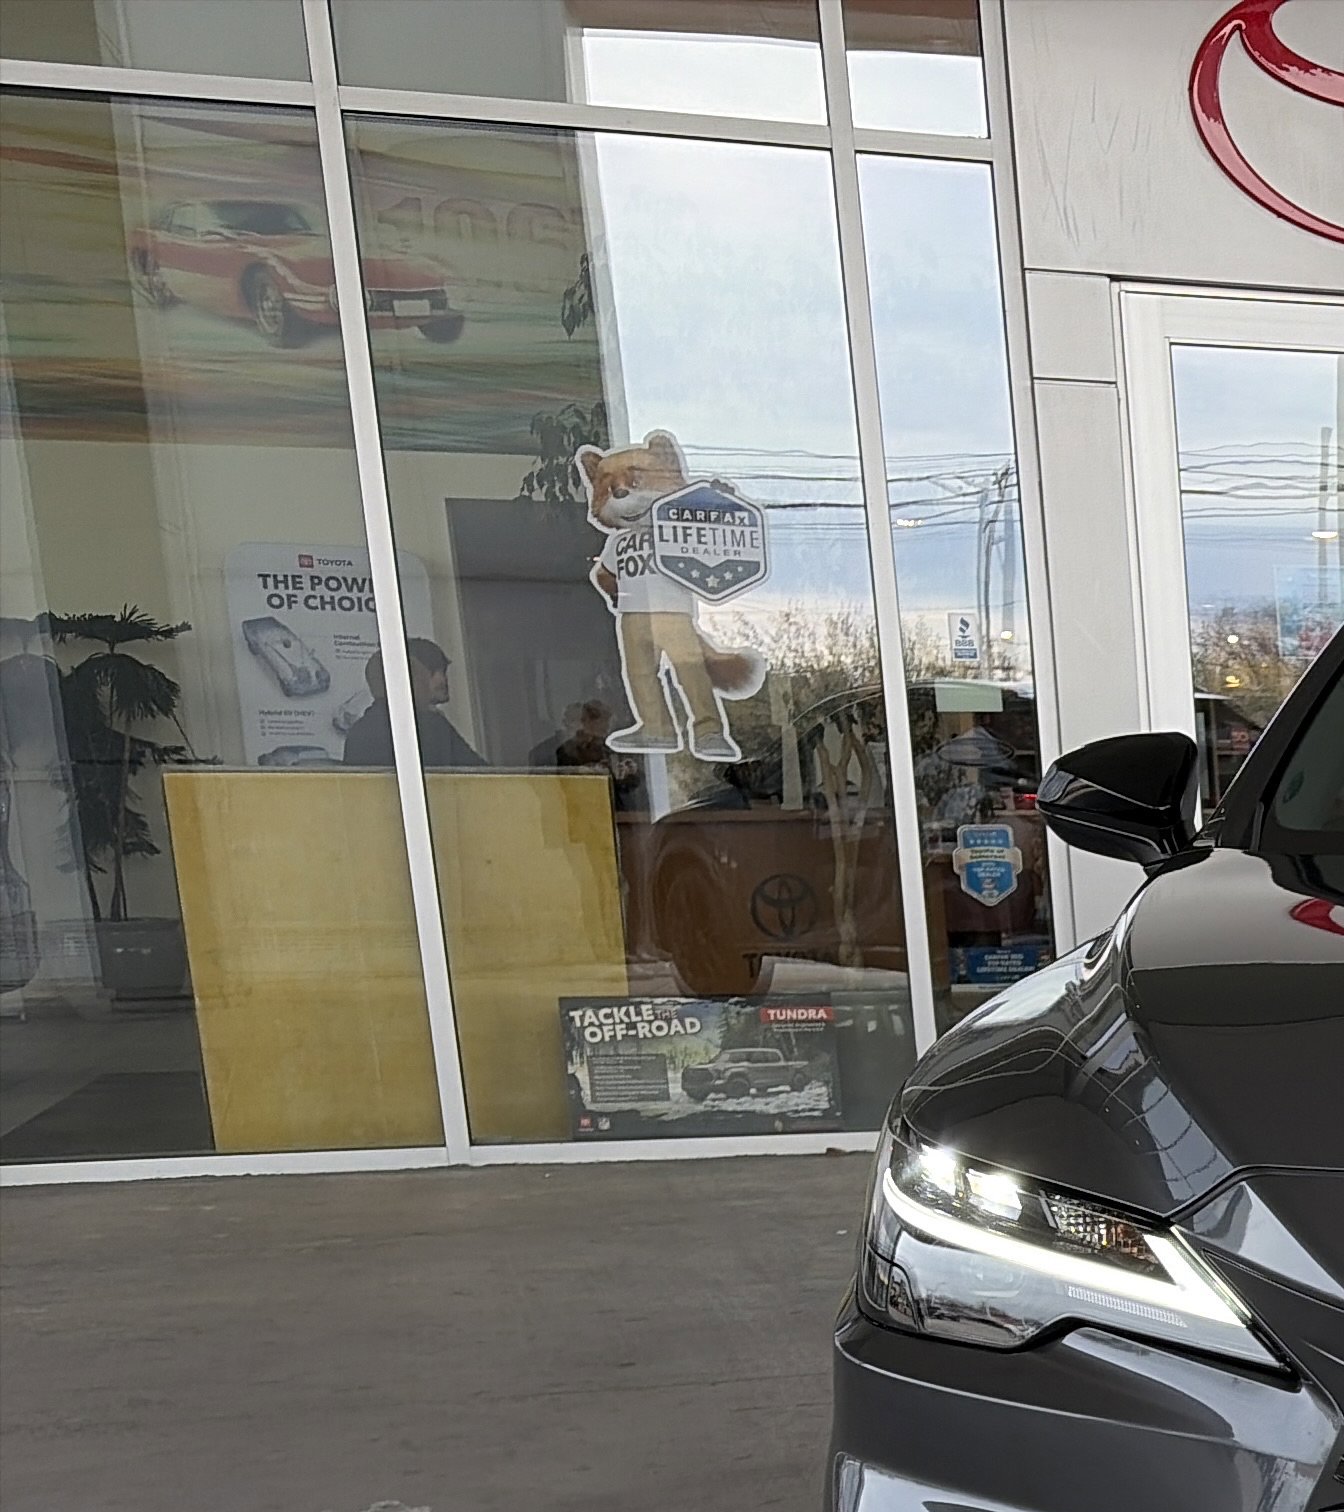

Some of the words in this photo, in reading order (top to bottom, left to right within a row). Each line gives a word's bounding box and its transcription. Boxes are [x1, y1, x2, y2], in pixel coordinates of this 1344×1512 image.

[668, 508, 749, 526] CARFAX
[658, 524, 761, 549] LIFETIME
[681, 546, 742, 558] DEALER
[316, 558, 353, 567] TOYOTA
[617, 552, 657, 580] FOX
[257, 573, 304, 591] THE
[310, 575, 375, 594] POW
[266, 593, 299, 610] OF
[303, 595, 377, 613] CHOIC
[569, 1003, 655, 1028] TACKLE
[655, 1006, 679, 1021] THE
[766, 1008, 828, 1022] TUNDRA
[584, 1017, 702, 1044] OFF-ROAD
